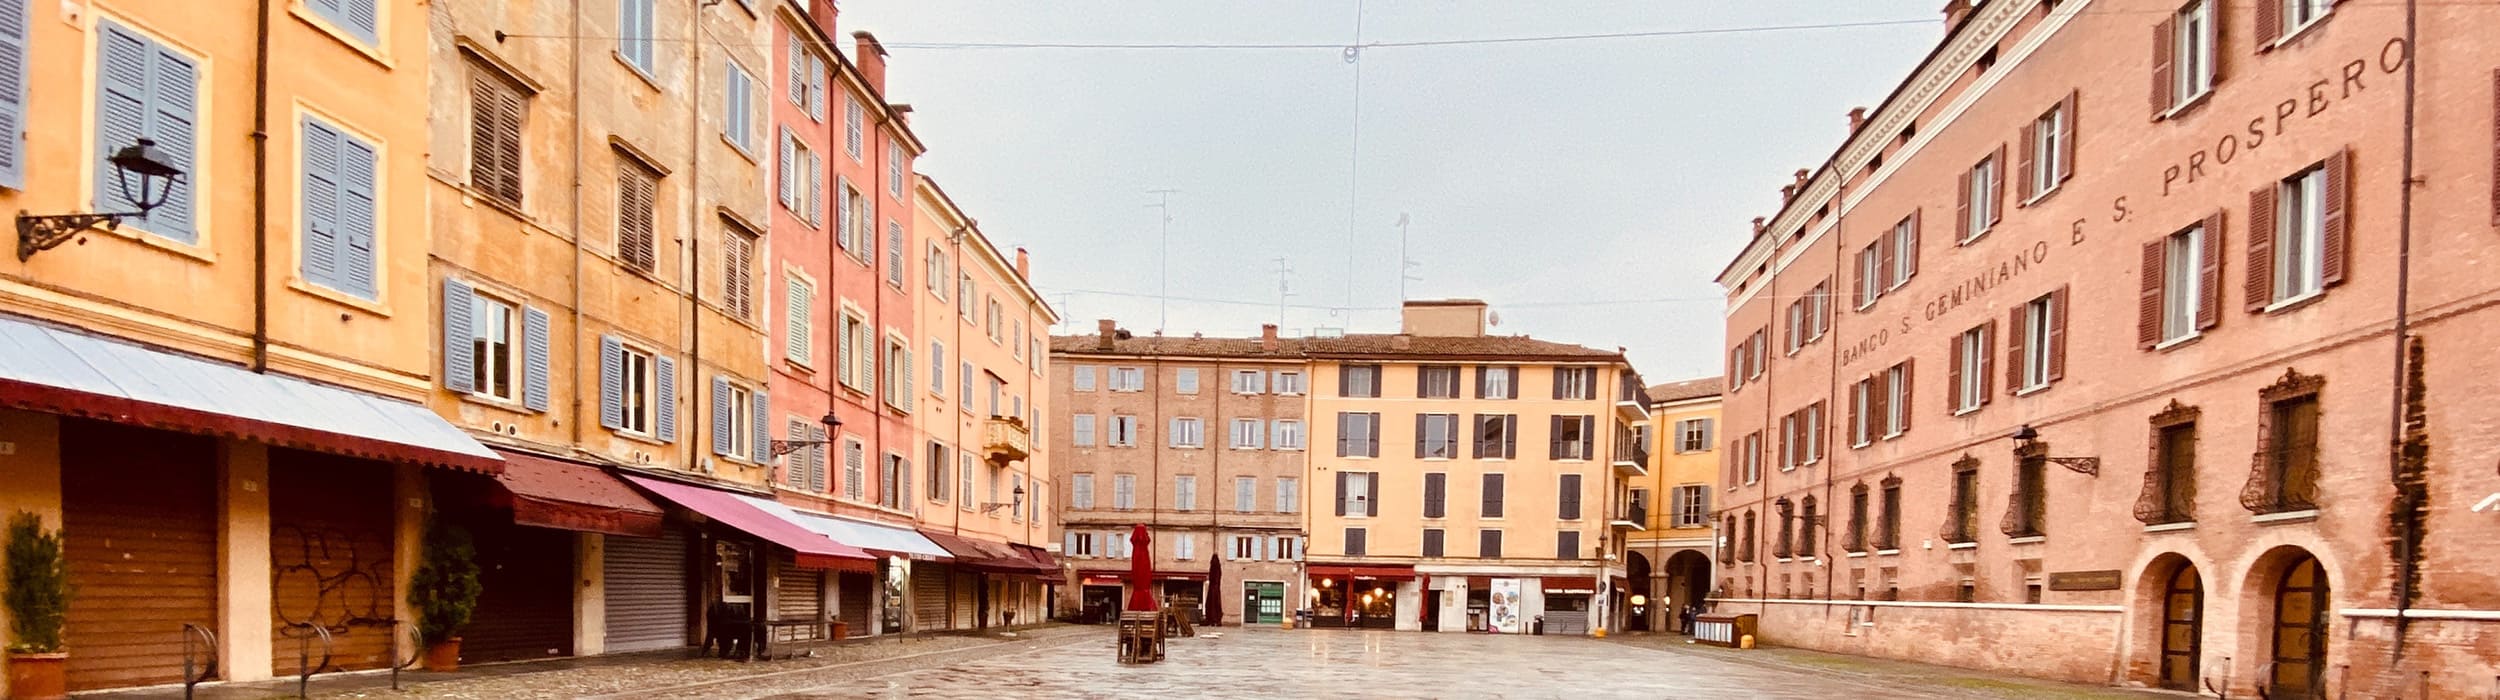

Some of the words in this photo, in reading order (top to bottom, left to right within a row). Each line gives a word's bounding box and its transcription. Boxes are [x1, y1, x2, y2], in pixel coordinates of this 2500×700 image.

[1842, 328, 1888, 366] BANCO
[1925, 240, 2047, 321] GEMINIANO
[2071, 218, 2086, 247] E
[2163, 37, 2405, 196] PROSPERO
